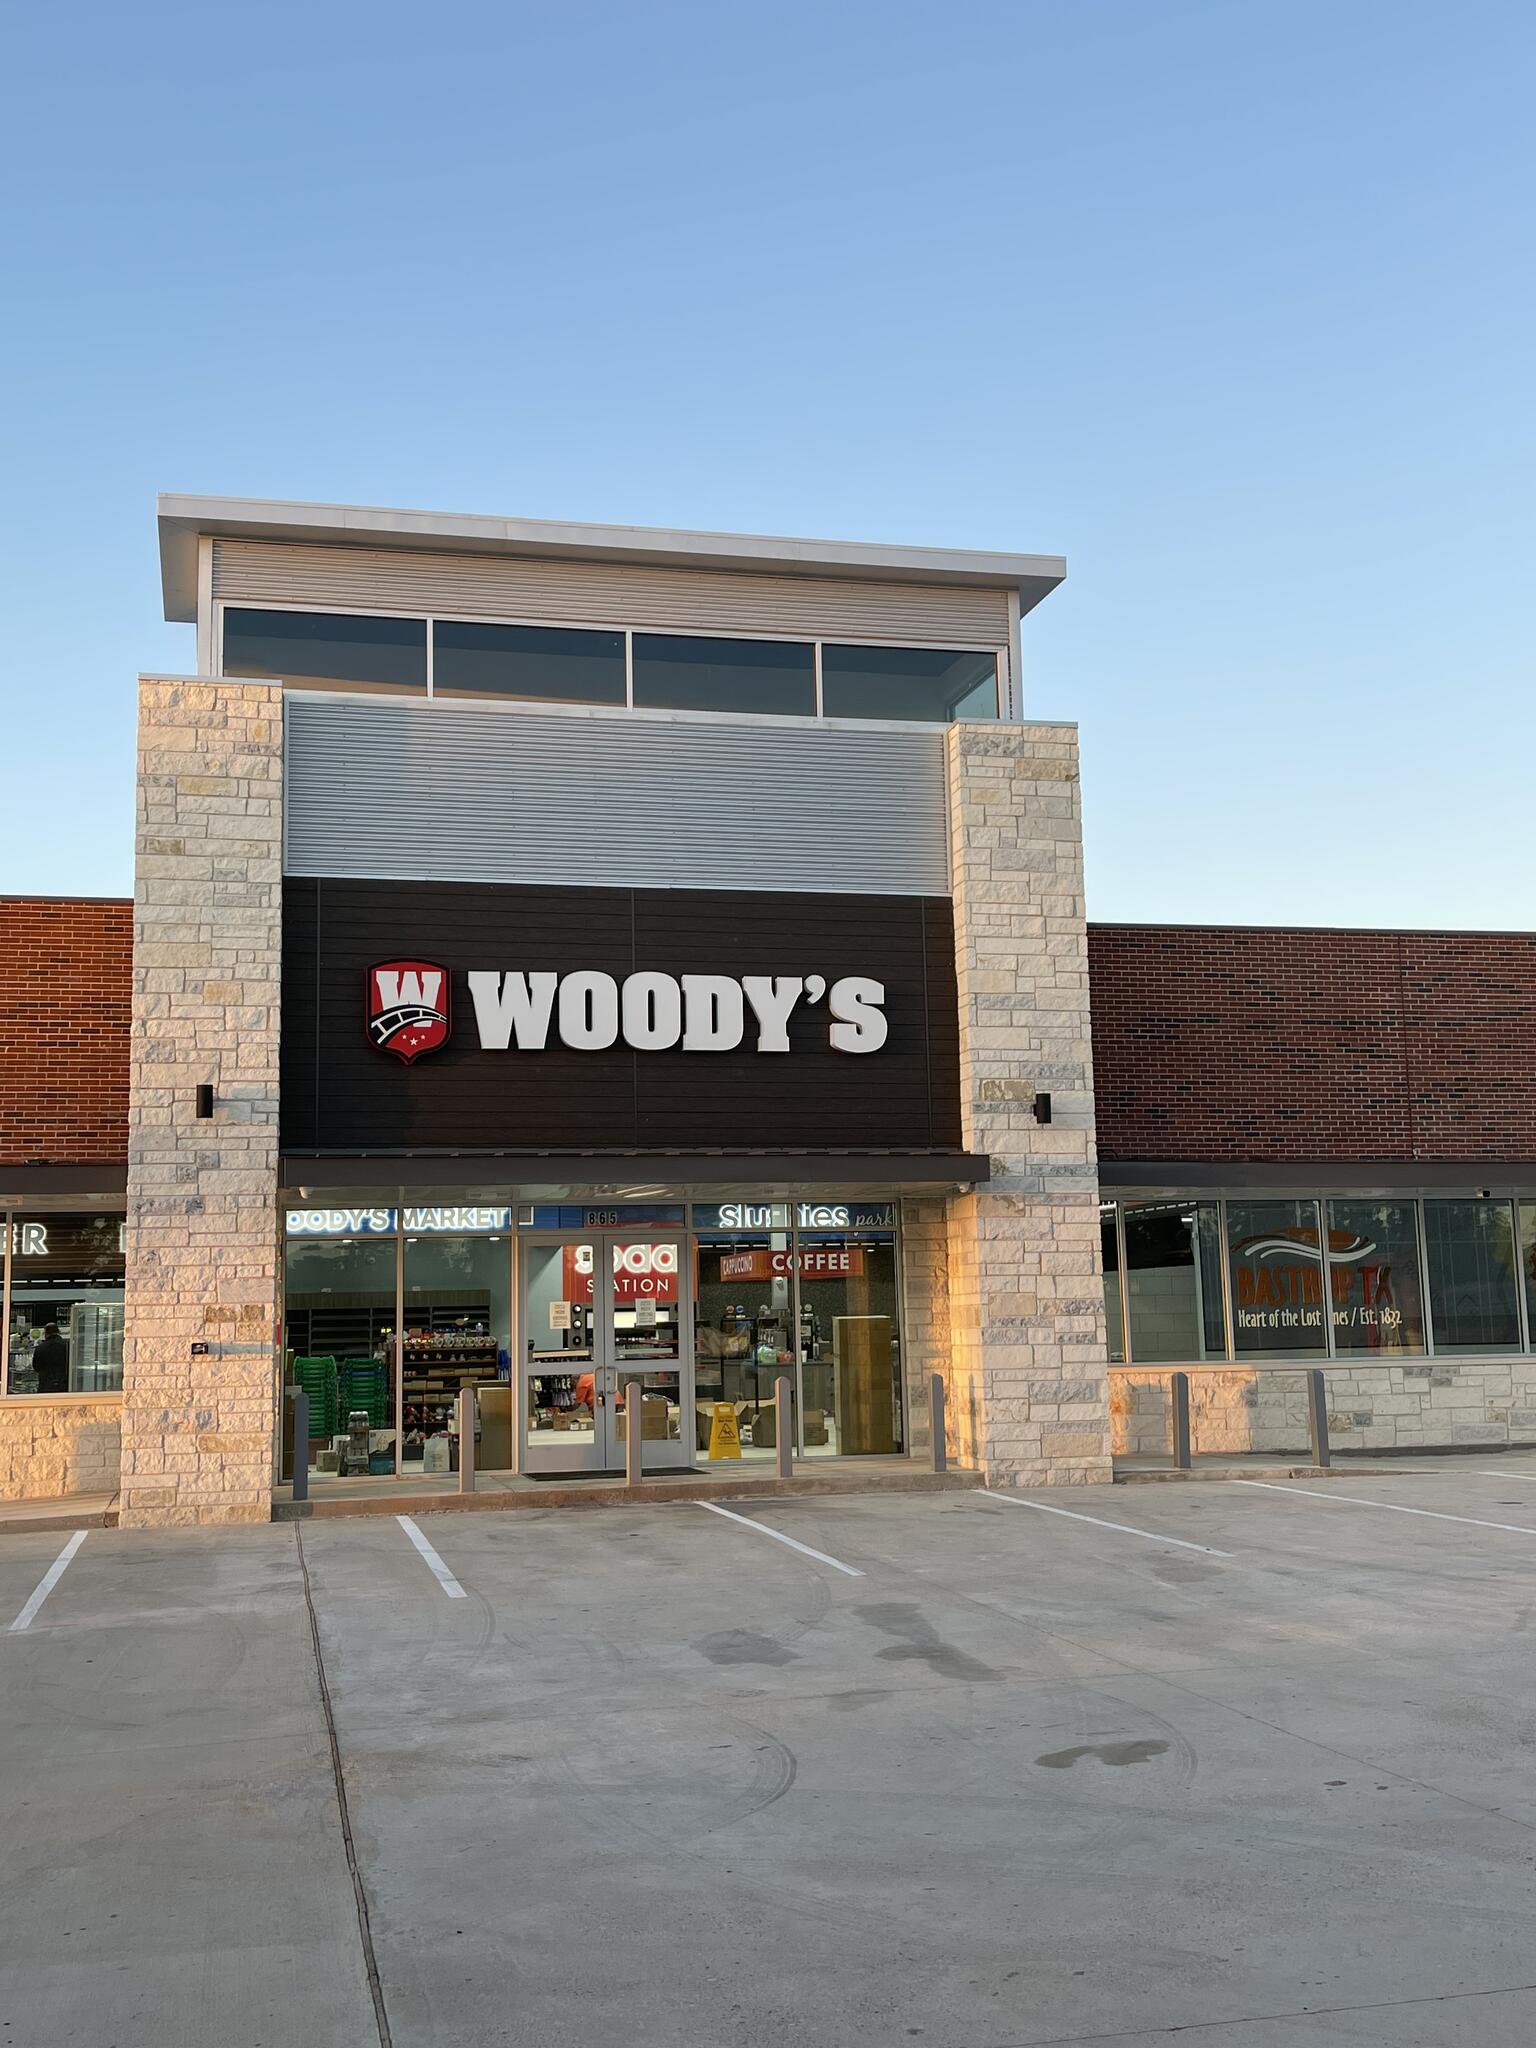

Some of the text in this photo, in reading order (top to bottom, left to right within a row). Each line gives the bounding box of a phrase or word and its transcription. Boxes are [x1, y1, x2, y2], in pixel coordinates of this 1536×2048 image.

[468, 970, 888, 1054] WOODY'S
[402, 1206, 508, 1230] MARKET
[588, 1211, 617, 1225] 865
[722, 1255, 753, 1276] CAPPUCCINO
[771, 1253, 850, 1271] COFFEE
[586, 1278, 669, 1293] SATION
[1238, 1309, 1267, 1328] Heart
[1268, 1308, 1281, 1329] of
[1281, 1308, 1299, 1327] the
[1300, 1308, 1322, 1327] Lost
[1359, 1306, 1378, 1326] Est.
[1378, 1306, 1403, 1329] 1832
